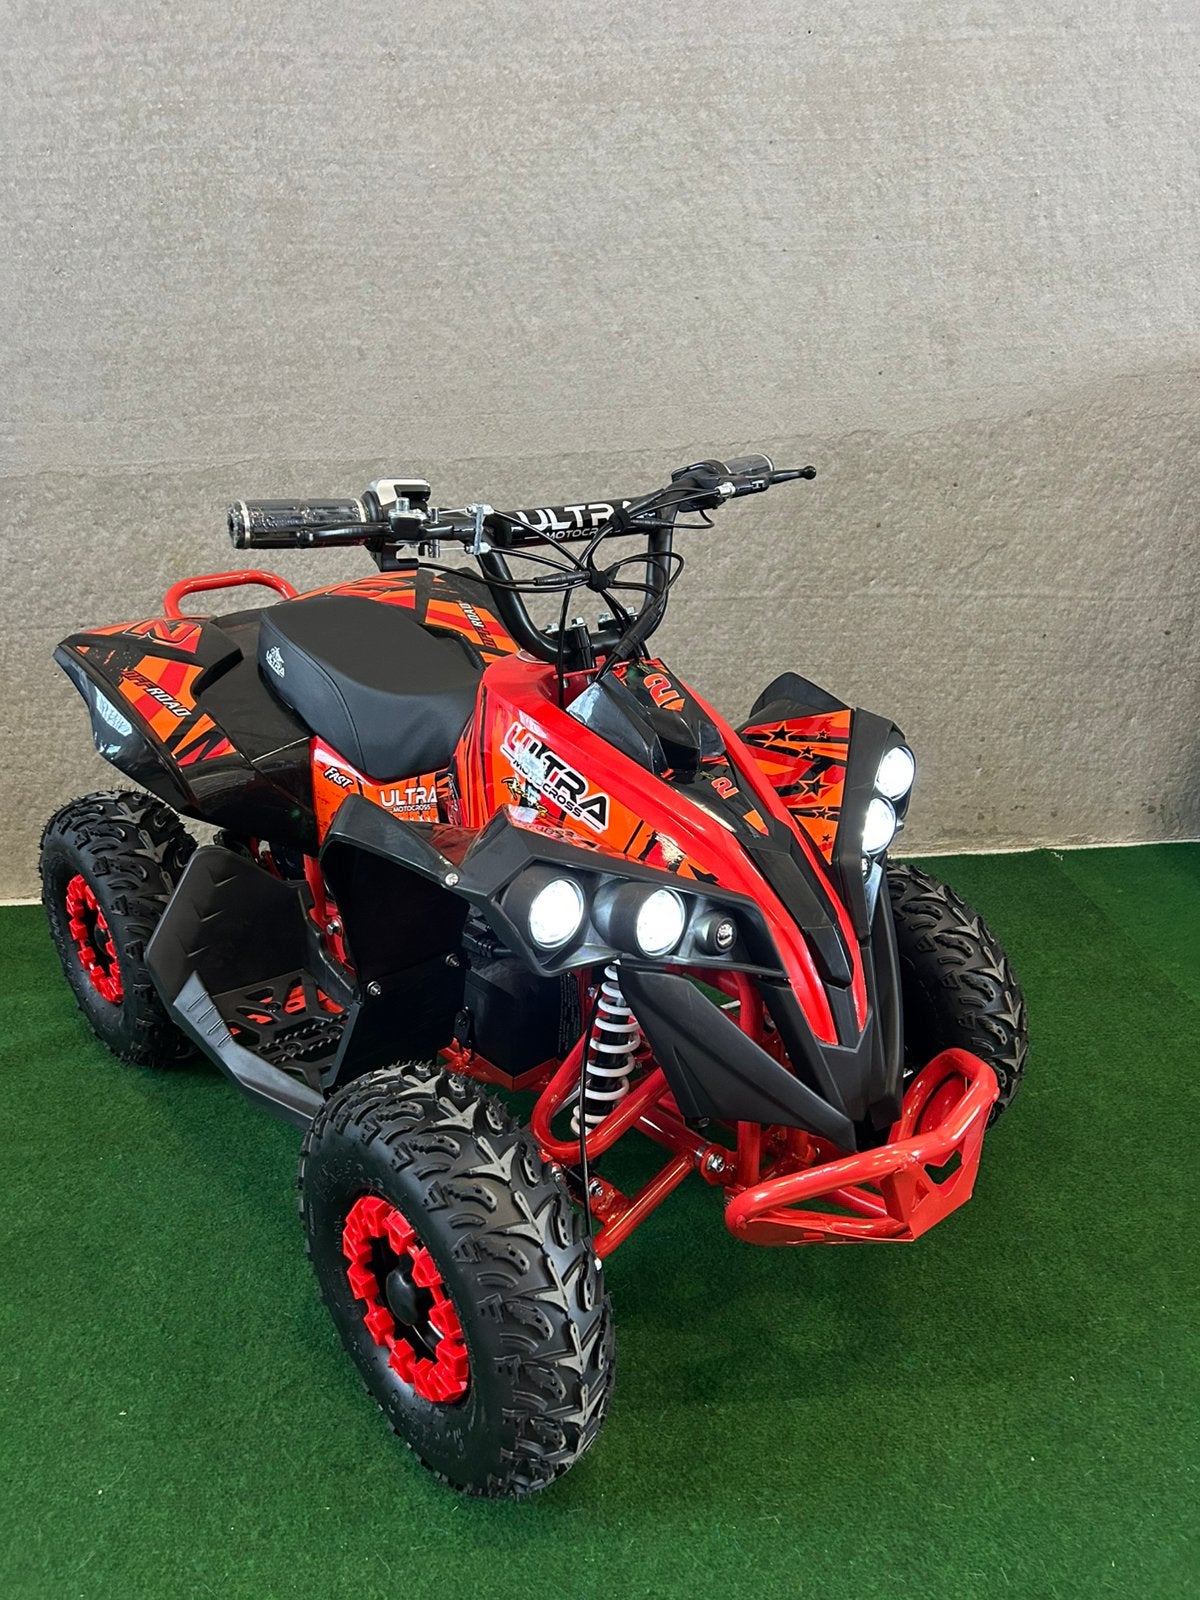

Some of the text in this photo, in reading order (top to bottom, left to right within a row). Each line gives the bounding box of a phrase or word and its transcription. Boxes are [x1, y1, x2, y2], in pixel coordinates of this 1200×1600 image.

[514, 500, 657, 531] ULTR
[546, 527, 621, 540] MOTOCR
[324, 766, 354, 788] FAST
[380, 785, 438, 807] ULTRA
[392, 804, 431, 813] MOTOCROSS
